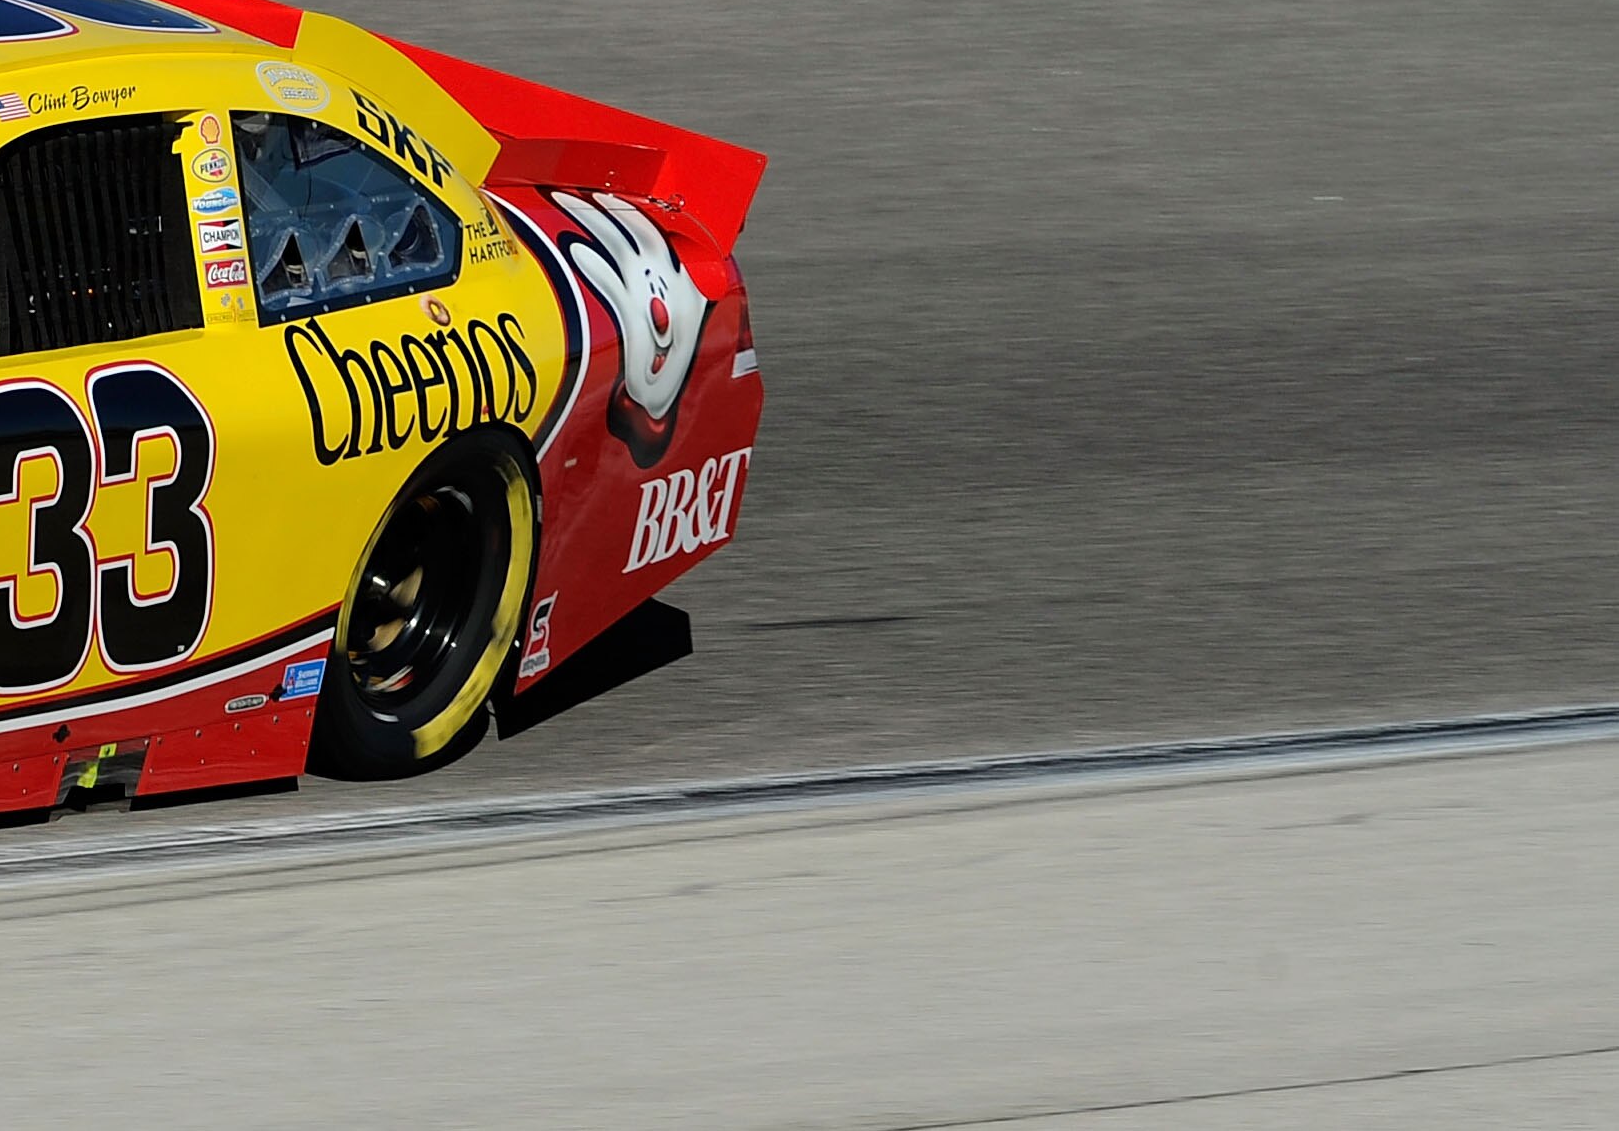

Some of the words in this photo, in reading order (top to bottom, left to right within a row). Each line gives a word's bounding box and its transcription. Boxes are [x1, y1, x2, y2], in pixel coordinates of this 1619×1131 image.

[28, 92, 67, 115] Clint
[71, 85, 136, 111] Bowyer
[203, 232, 240, 245] CHAMPION
[465, 221, 487, 241] THE
[284, 311, 538, 466] Cheerios
[621, 446, 754, 574] BB&T
